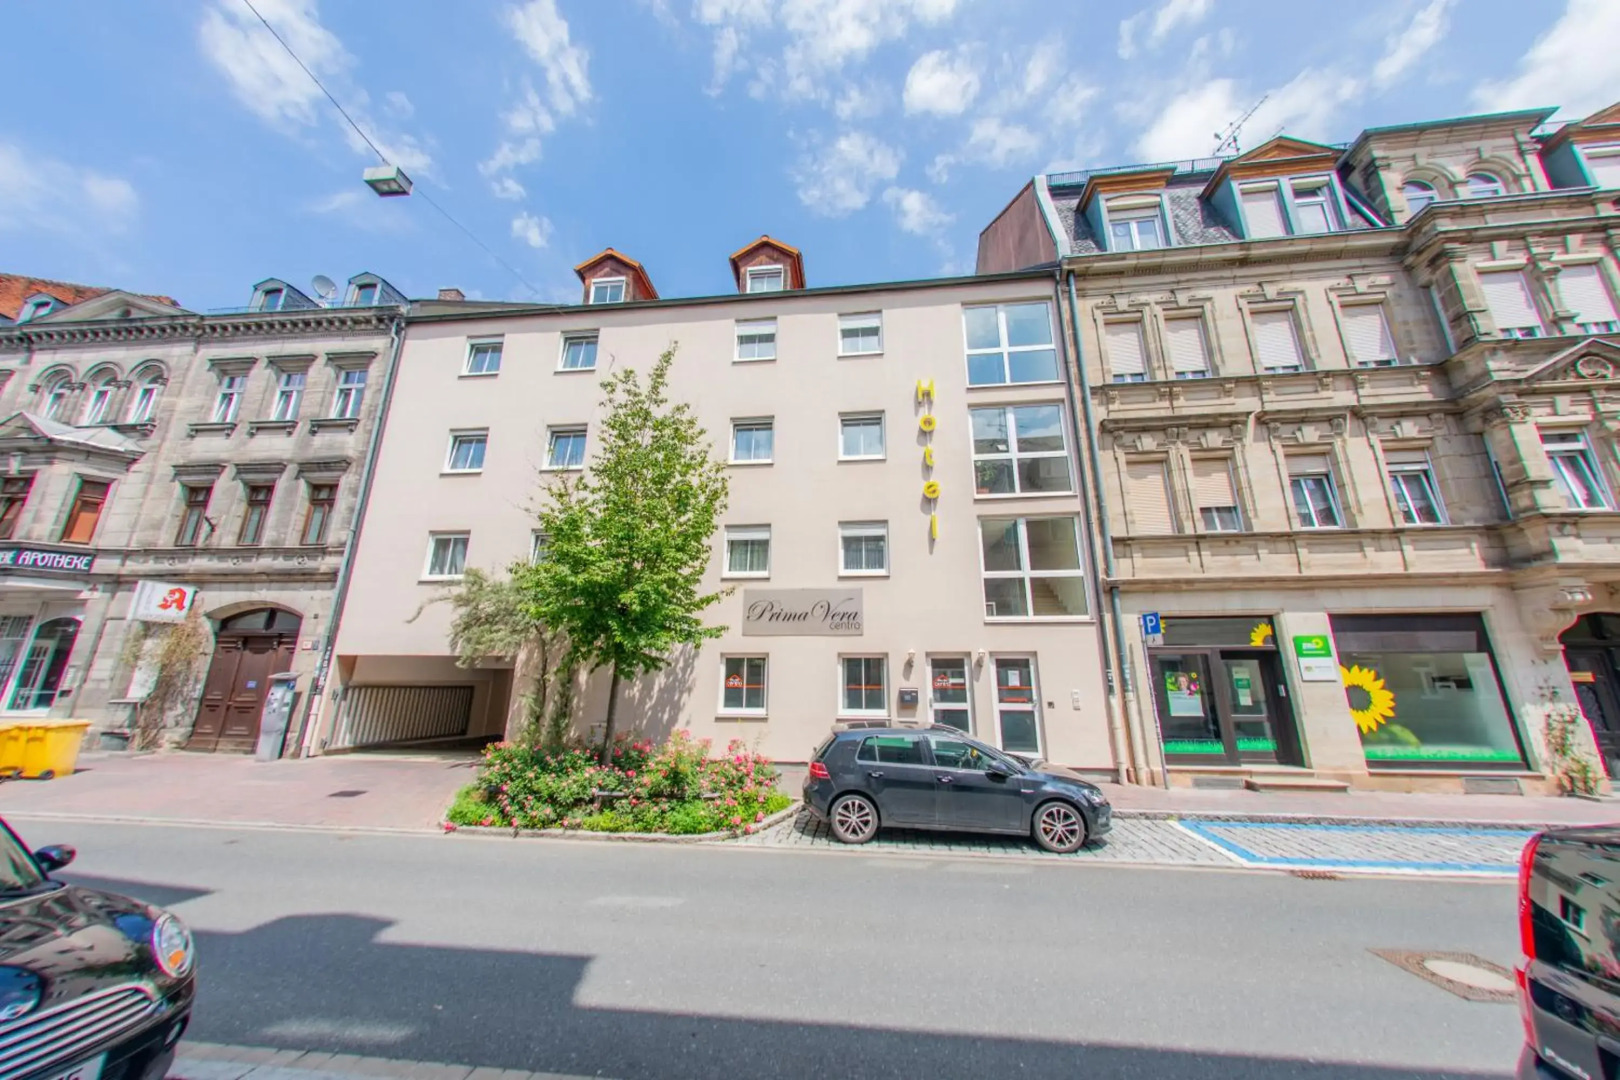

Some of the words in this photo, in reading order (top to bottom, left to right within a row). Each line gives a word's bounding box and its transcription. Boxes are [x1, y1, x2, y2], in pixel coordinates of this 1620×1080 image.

[18, 551, 93, 570] APOTHEKE
[746, 600, 809, 622] Prima
[811, 598, 859, 622] Vera
[829, 621, 861, 630] centro
[1146, 615, 1156, 633] P
